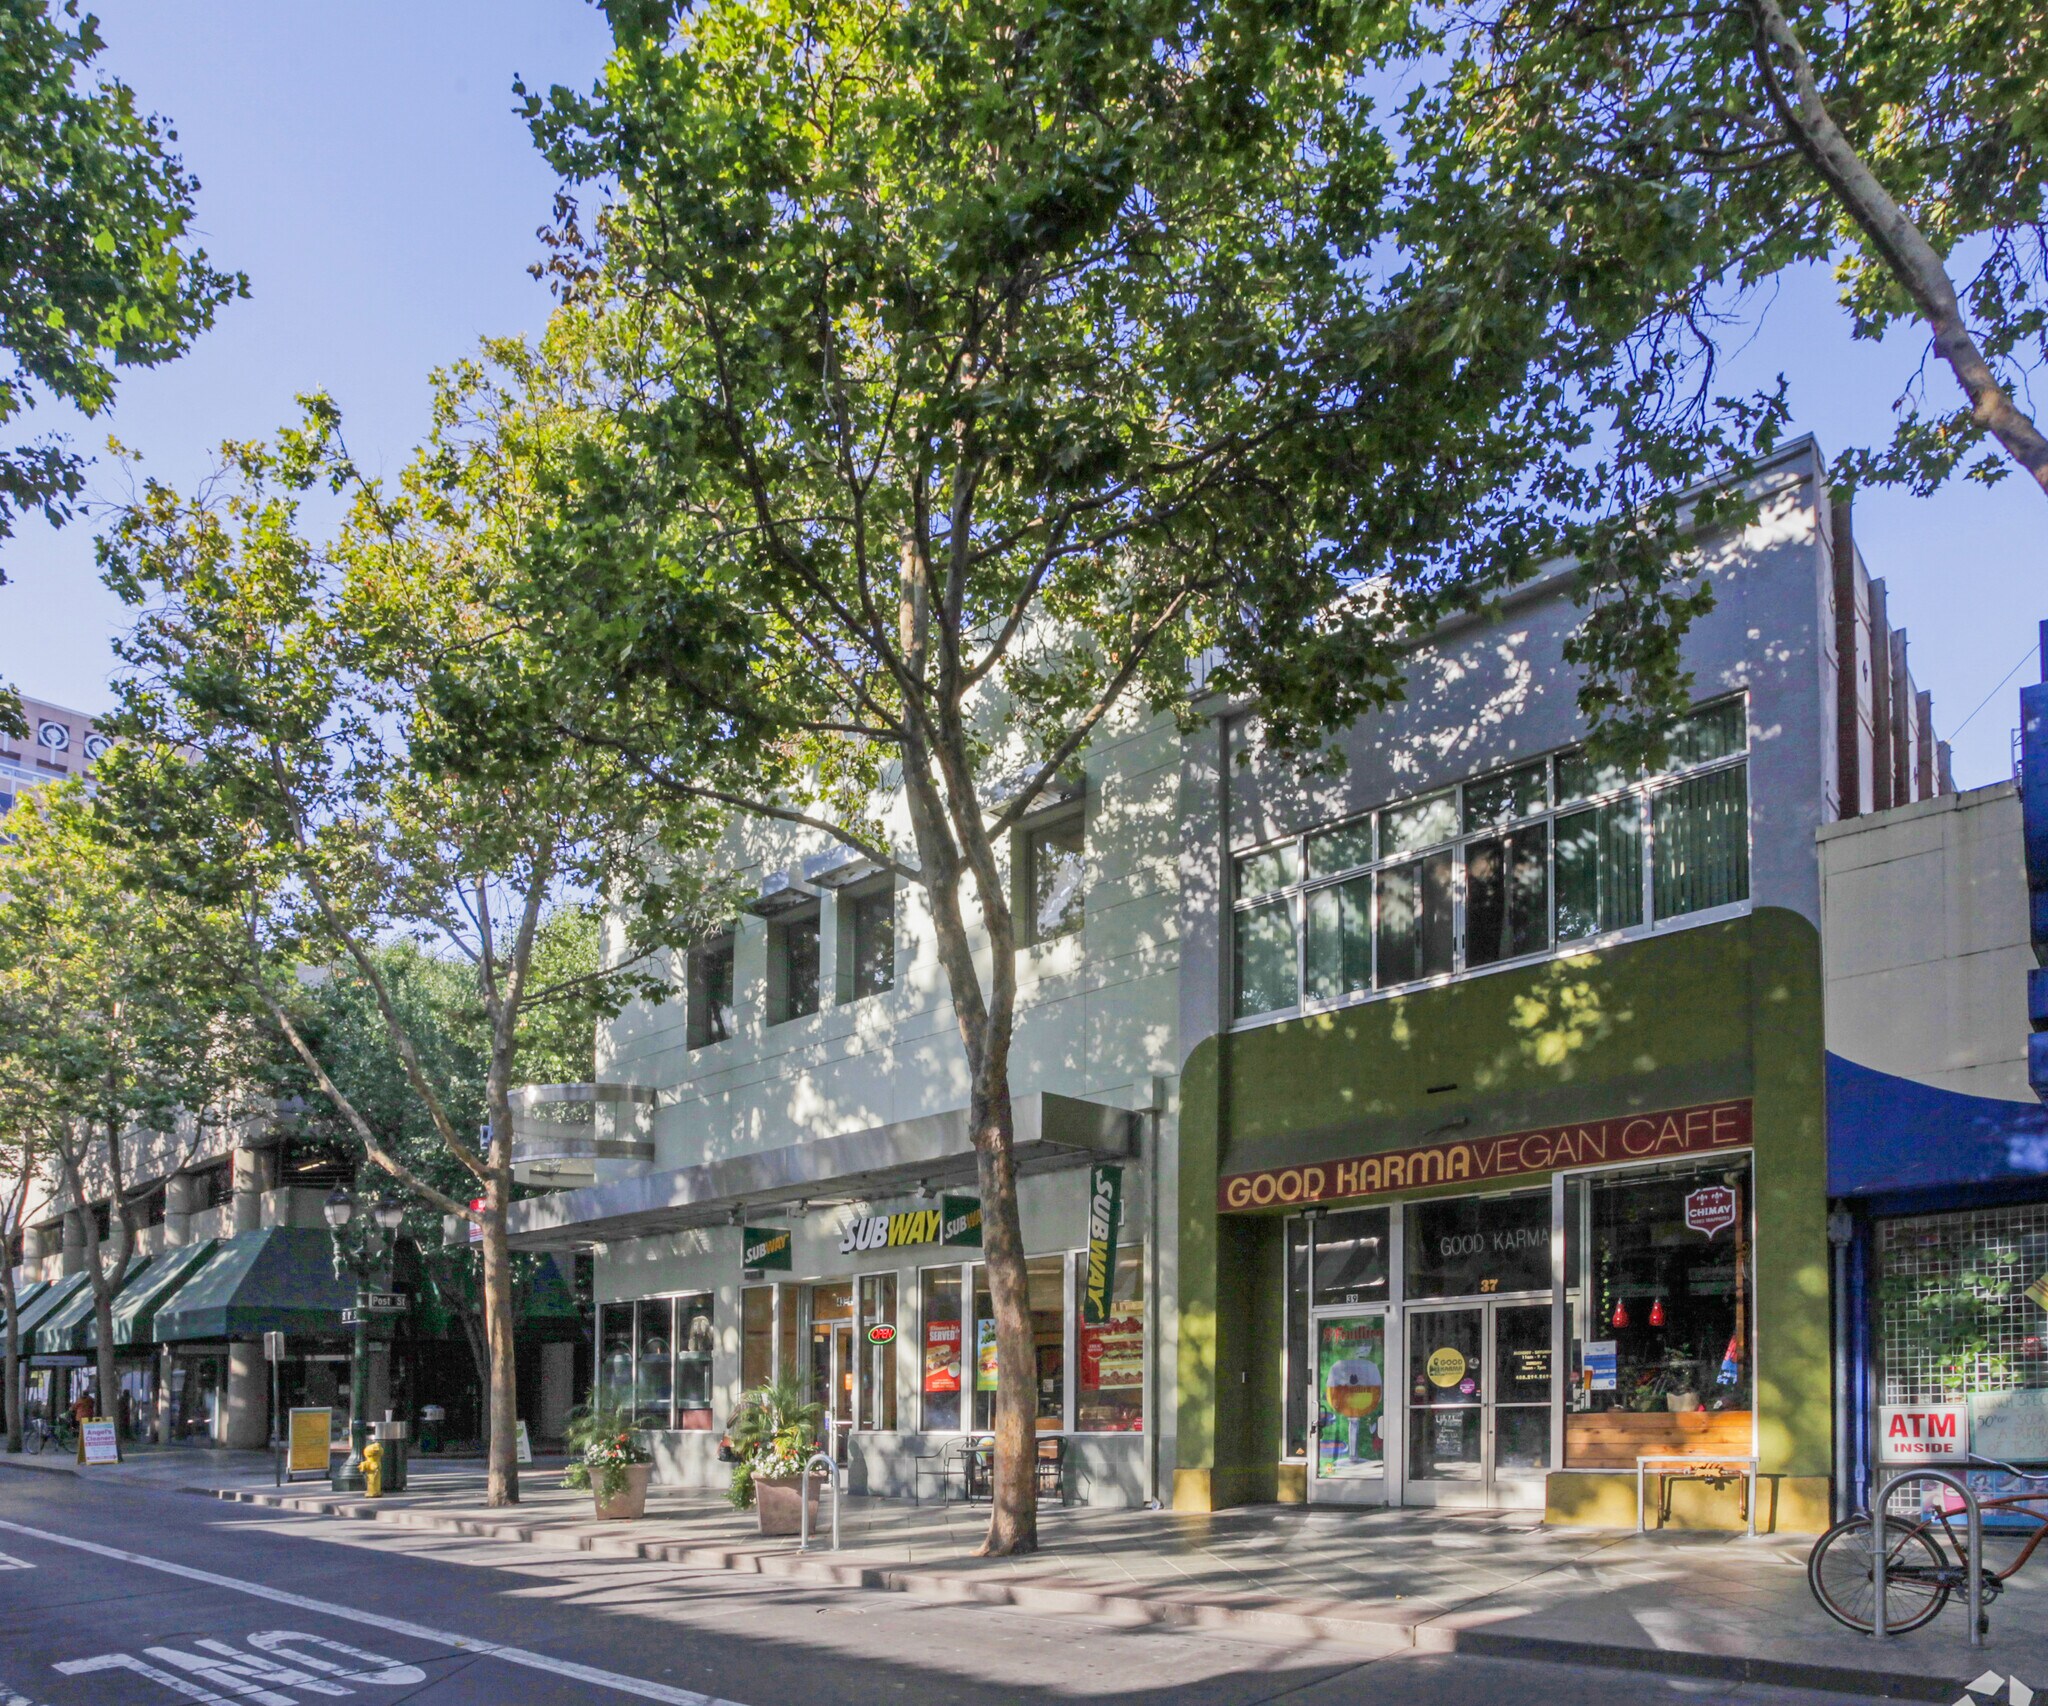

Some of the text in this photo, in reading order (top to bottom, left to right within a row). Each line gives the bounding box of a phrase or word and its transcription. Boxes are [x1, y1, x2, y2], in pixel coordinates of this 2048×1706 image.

[1227, 1106, 1738, 1208] GOOD KARMA VEGAN CAFE
[1689, 1204, 1732, 1217] CHIMAY
[839, 1210, 941, 1254] SUBWAY
[944, 1208, 983, 1240] SUBWA
[744, 1232, 790, 1264] SUBWAY
[1088, 1168, 1113, 1320] SUBWAY
[1440, 1228, 1551, 1256] GOOD KARMA
[1480, 1278, 1498, 1293] 37
[372, 1296, 405, 1306] Post St
[1347, 1295, 1358, 1303] 39
[871, 1328, 893, 1339] OPEN
[929, 1330, 955, 1341] SERVED
[1888, 1413, 1956, 1438] ATM
[1894, 1443, 1954, 1453] INSIDE
